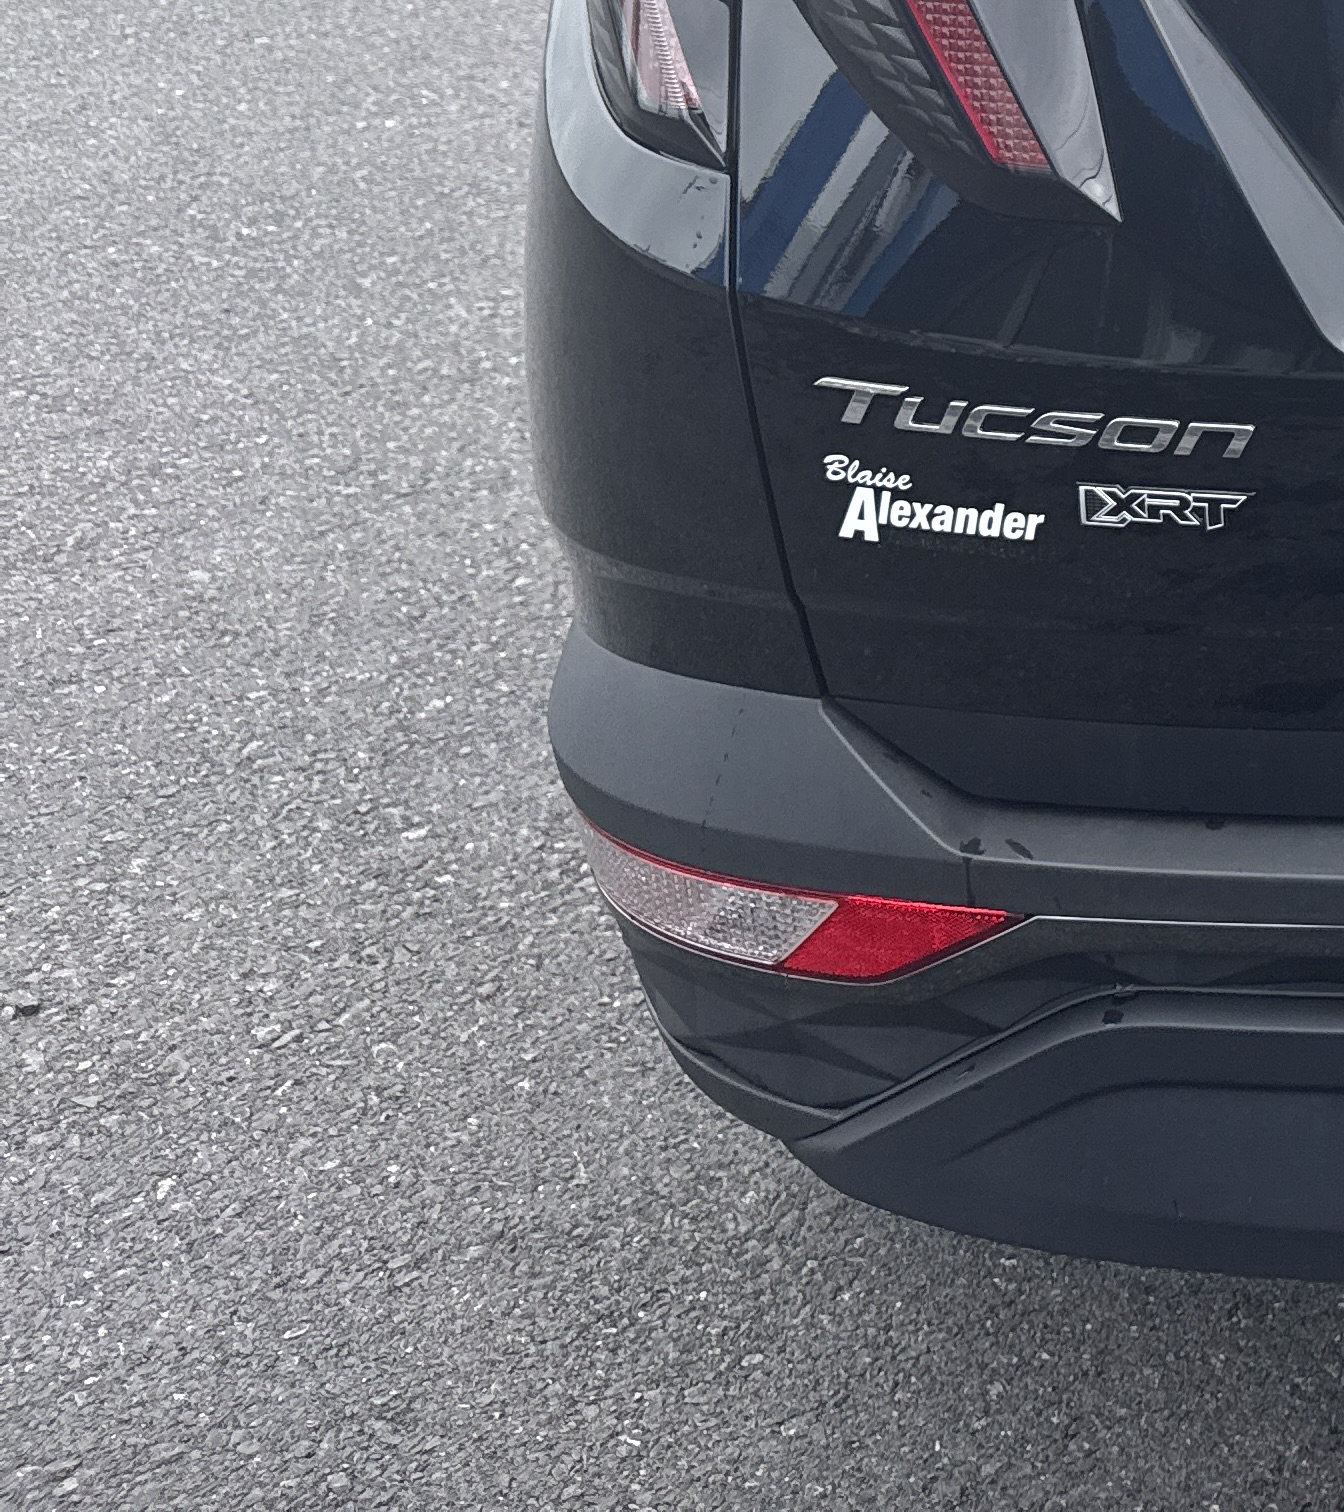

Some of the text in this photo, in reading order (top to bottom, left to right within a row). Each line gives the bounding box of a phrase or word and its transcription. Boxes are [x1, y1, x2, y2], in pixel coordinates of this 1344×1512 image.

[823, 454, 913, 490] Blaise
[838, 486, 1046, 542] Alexander
[1088, 482, 1257, 531] XRT
